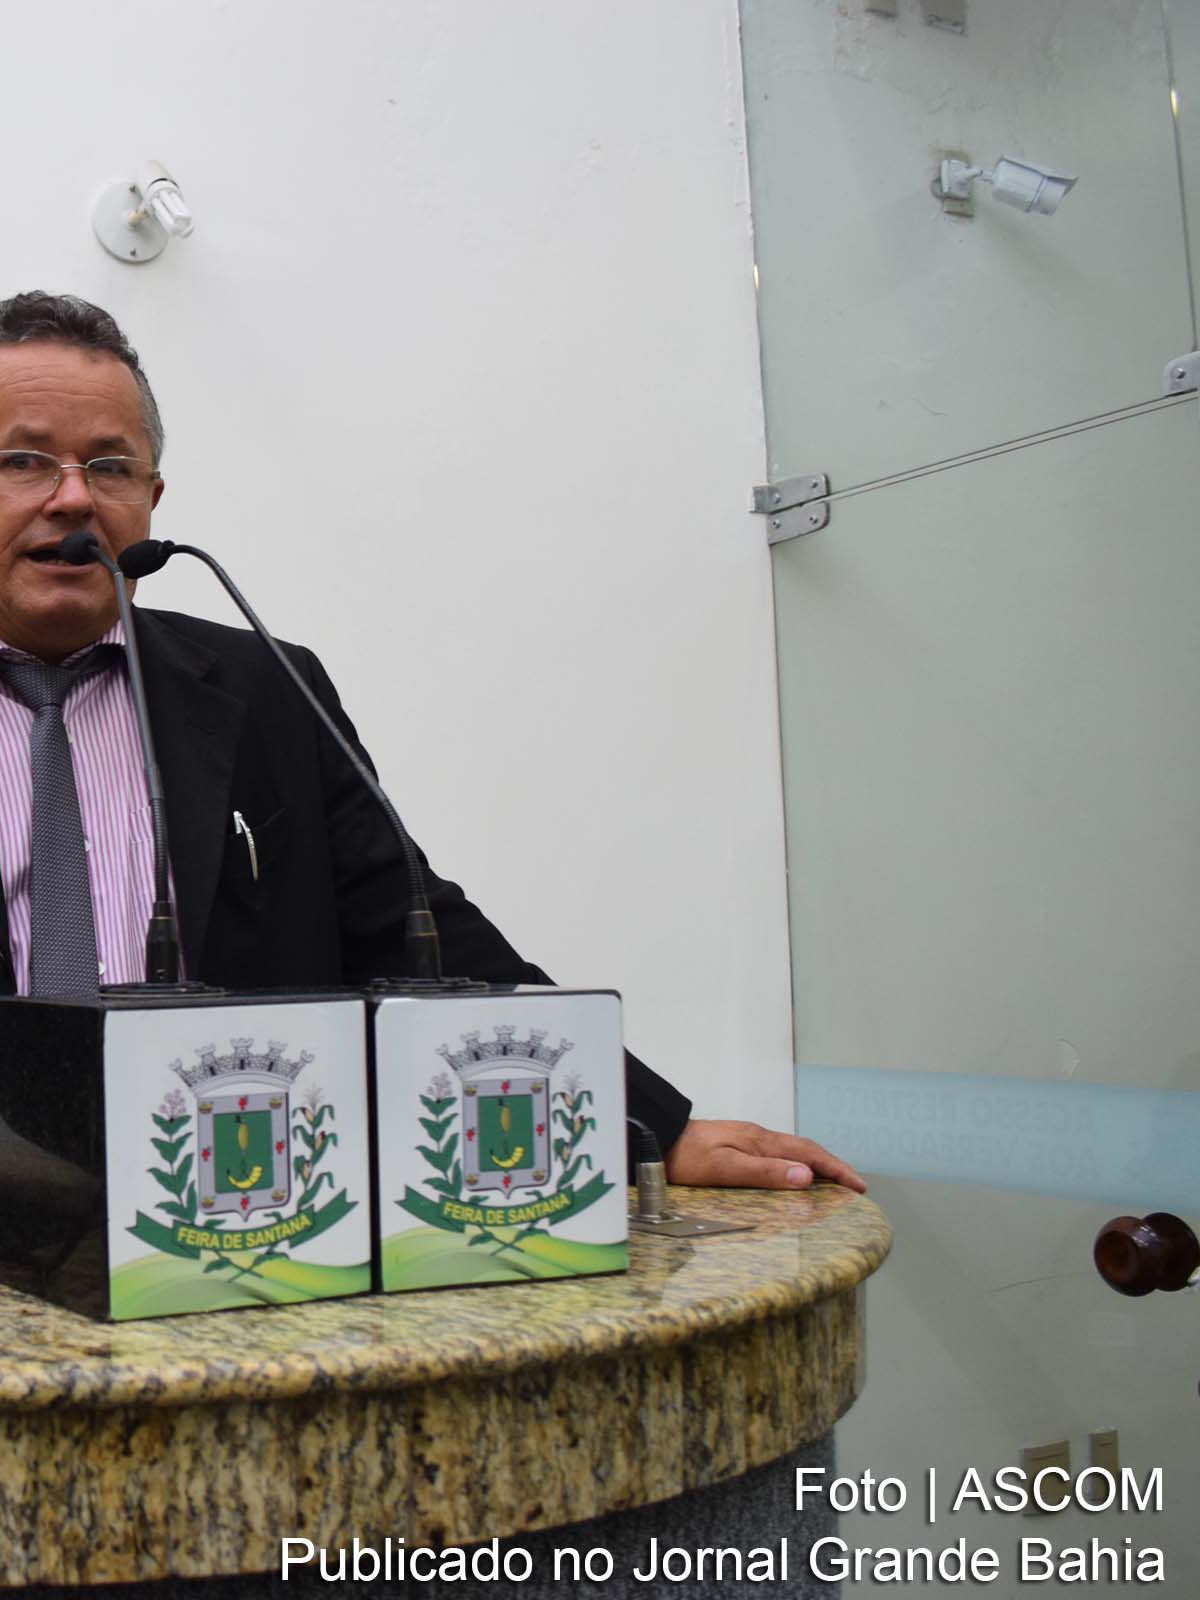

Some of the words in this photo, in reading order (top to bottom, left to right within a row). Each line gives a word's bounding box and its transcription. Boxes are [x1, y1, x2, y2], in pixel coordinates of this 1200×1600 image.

[443, 1201, 484, 1223] FEIRA
[486, 1209, 505, 1224] DE
[507, 1193, 570, 1223] SANTANA
[177, 1226, 220, 1249] FEIRA
[222, 1233, 243, 1249] DE
[245, 1213, 312, 1248] SANTANA
